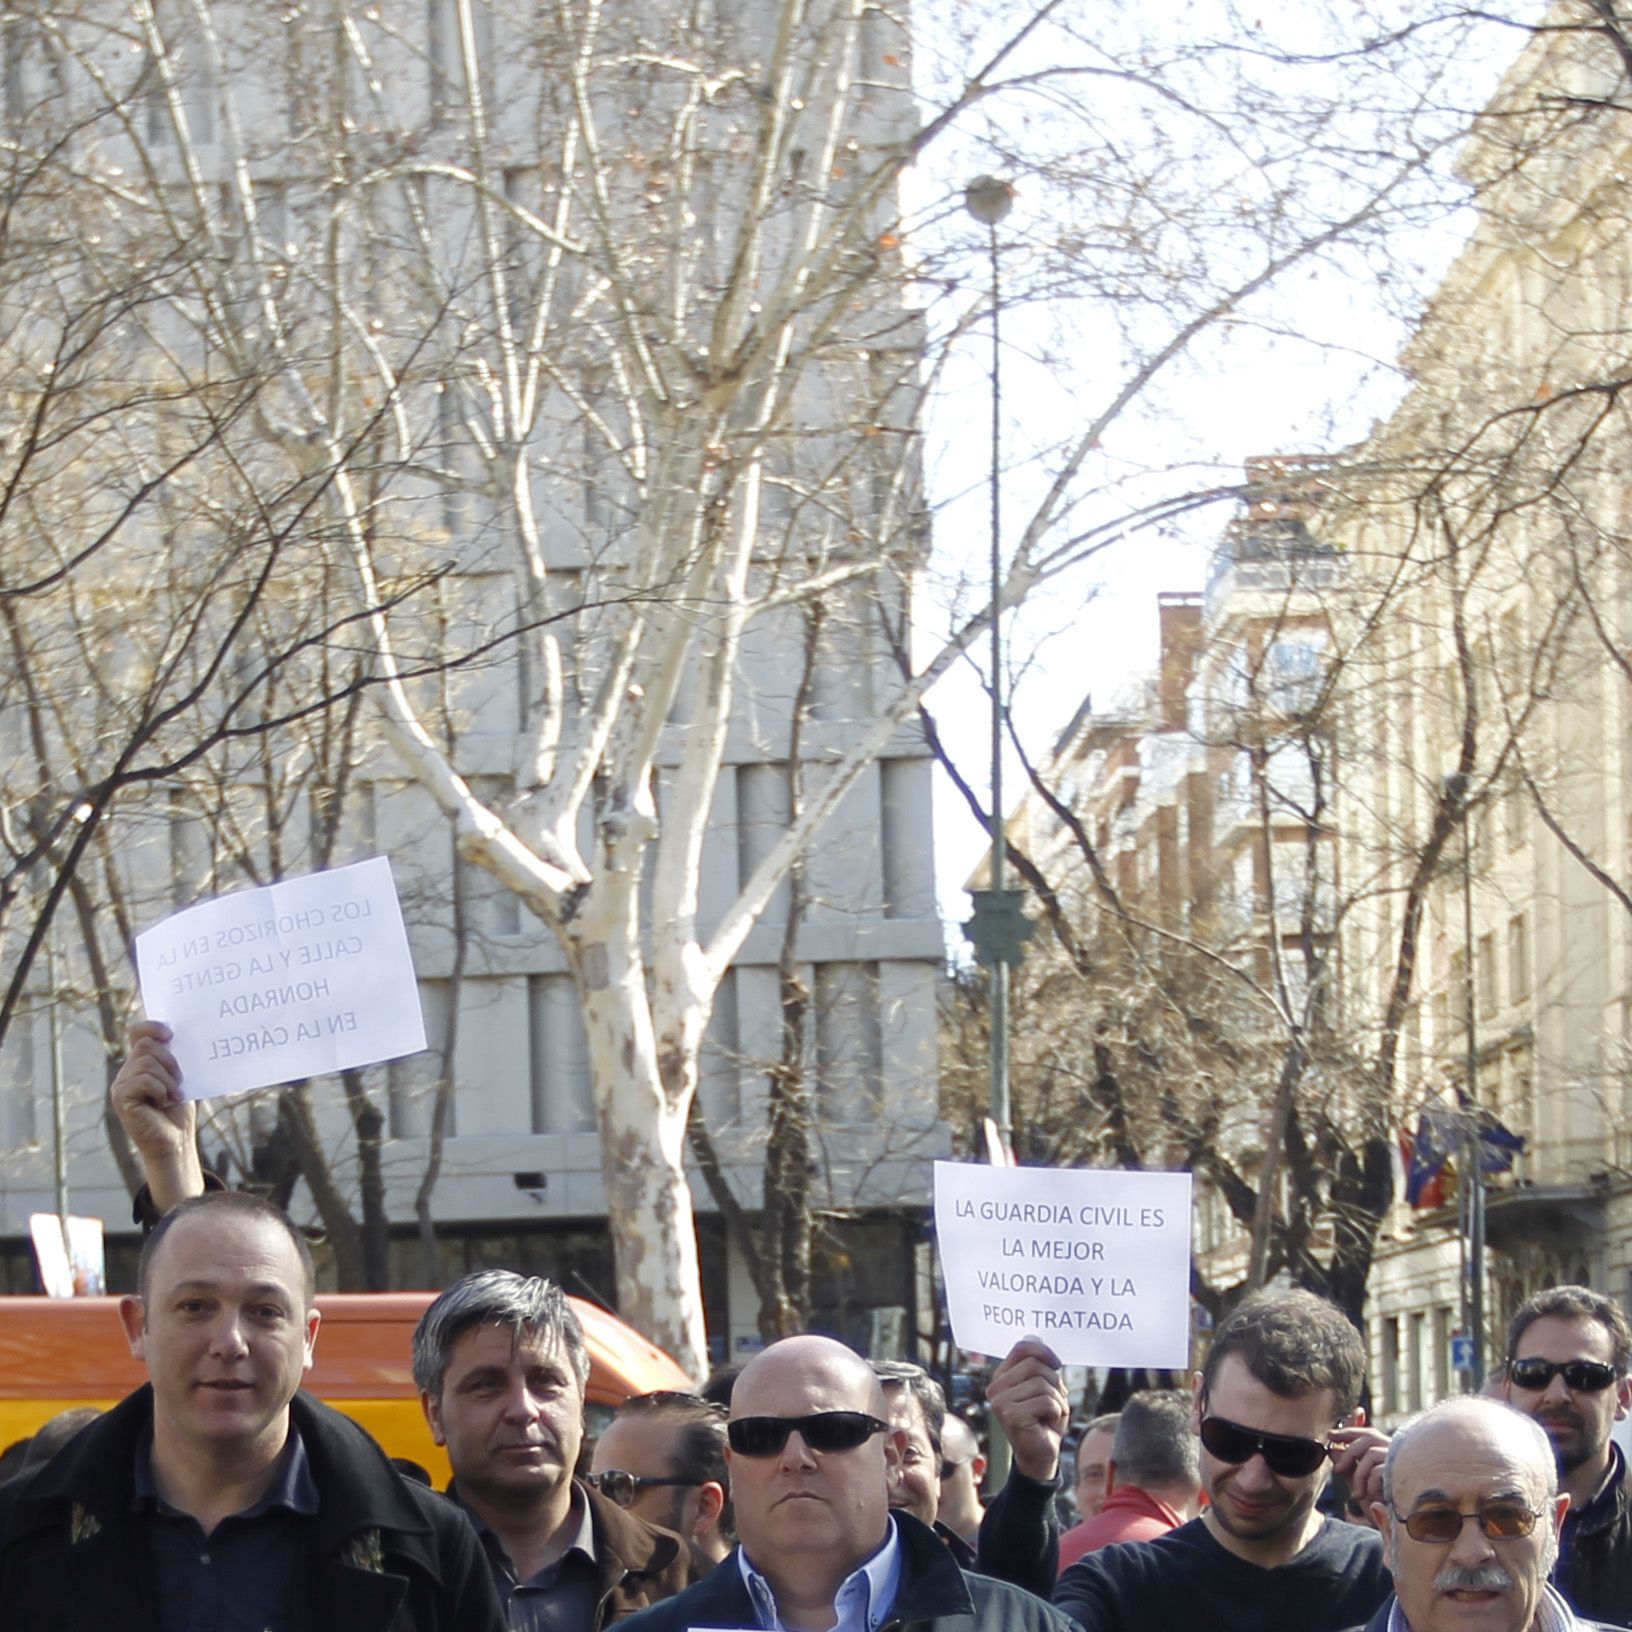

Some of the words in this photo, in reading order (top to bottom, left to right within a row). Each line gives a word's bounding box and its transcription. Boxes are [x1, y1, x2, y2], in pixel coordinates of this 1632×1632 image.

[955, 1199, 975, 1218] LA
[980, 1202, 1073, 1224] GUARDIA
[1079, 1207, 1133, 1226] CIVIL
[1140, 1209, 1165, 1228] ES
[1002, 1238, 1024, 1257] LA
[1031, 1240, 1105, 1261] MEJOR
[977, 1270, 1084, 1295] VALORADA
[1091, 1277, 1104, 1295] Y
[1110, 1278, 1136, 1297] LA
[983, 1304, 1025, 1327] PEOR
[1032, 1310, 1133, 1331] TRATADA
